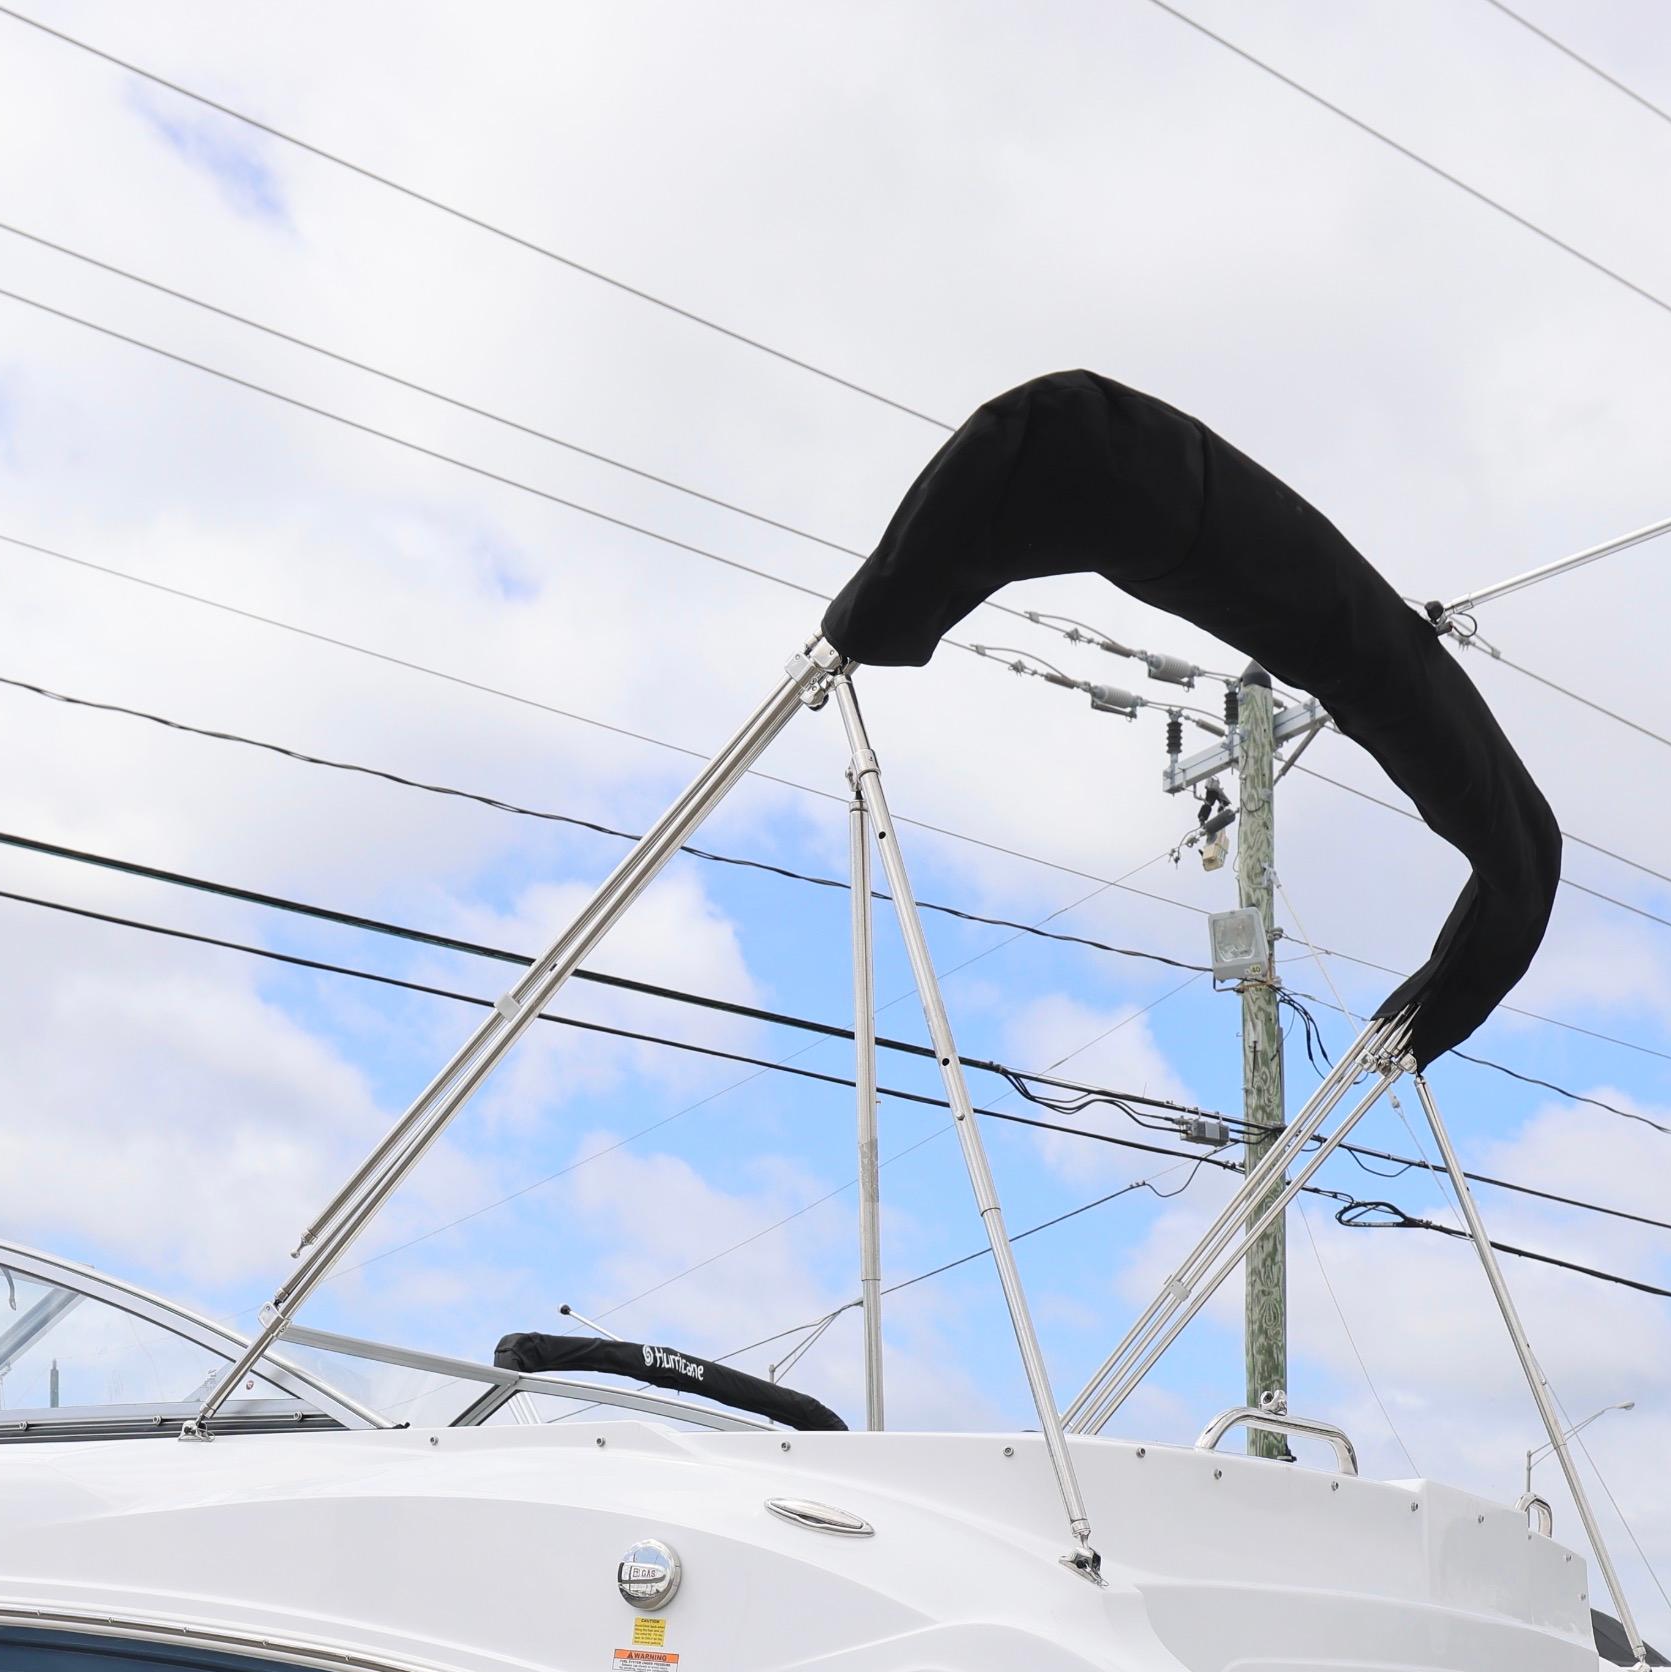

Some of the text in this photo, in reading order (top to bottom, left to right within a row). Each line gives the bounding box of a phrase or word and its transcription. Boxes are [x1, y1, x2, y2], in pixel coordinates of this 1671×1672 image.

[654, 1347, 704, 1381] Hurricane
[641, 1569, 656, 1578] GAS
[634, 1652, 667, 1662] WARNING
